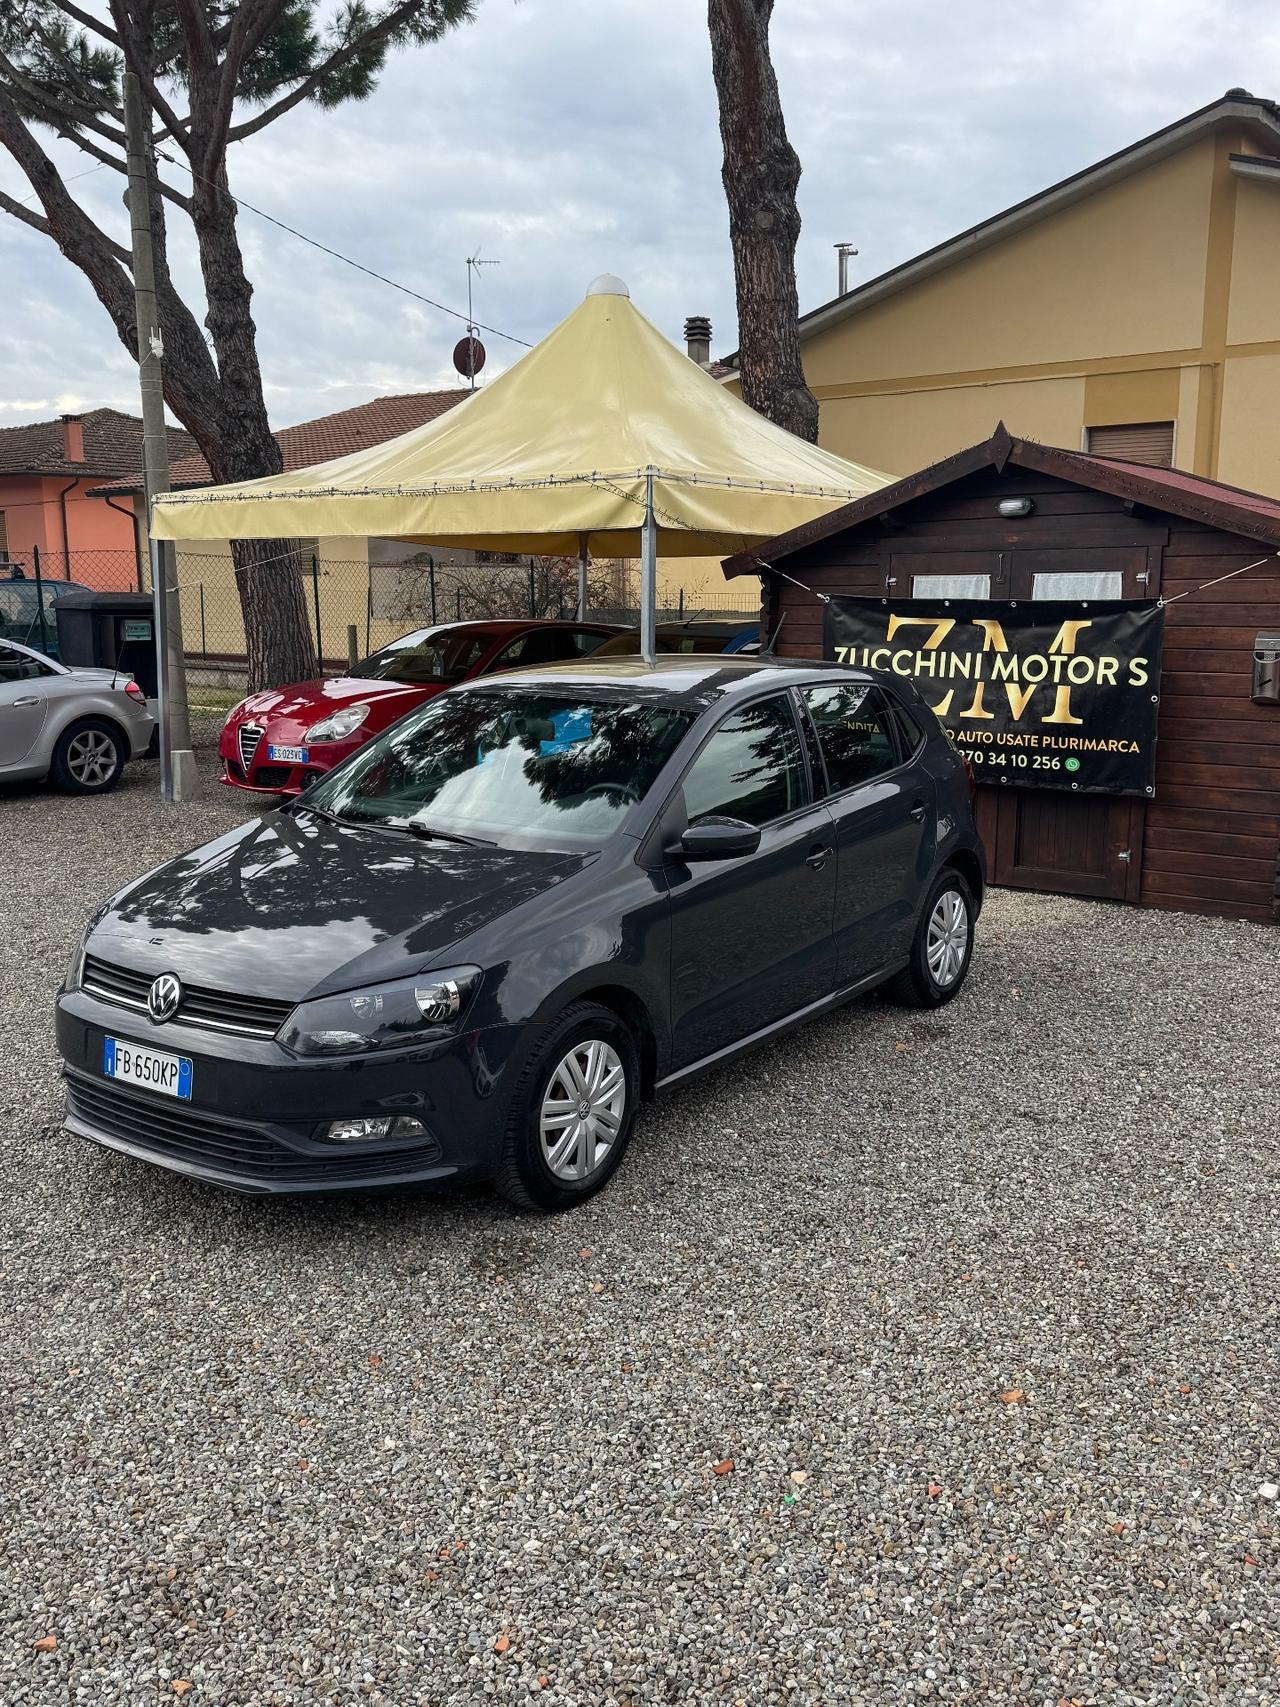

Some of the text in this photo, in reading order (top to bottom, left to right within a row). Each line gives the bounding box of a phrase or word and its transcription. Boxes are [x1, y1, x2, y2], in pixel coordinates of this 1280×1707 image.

[834, 646, 982, 680] ZUCCHINI
[957, 730, 994, 744] AUTO
[997, 733, 1039, 747] USATE
[1042, 736, 1140, 753] PLURIMARCA
[988, 752, 1007, 766] 34
[1011, 754, 1028, 767] 10
[1032, 756, 1061, 770] 256
